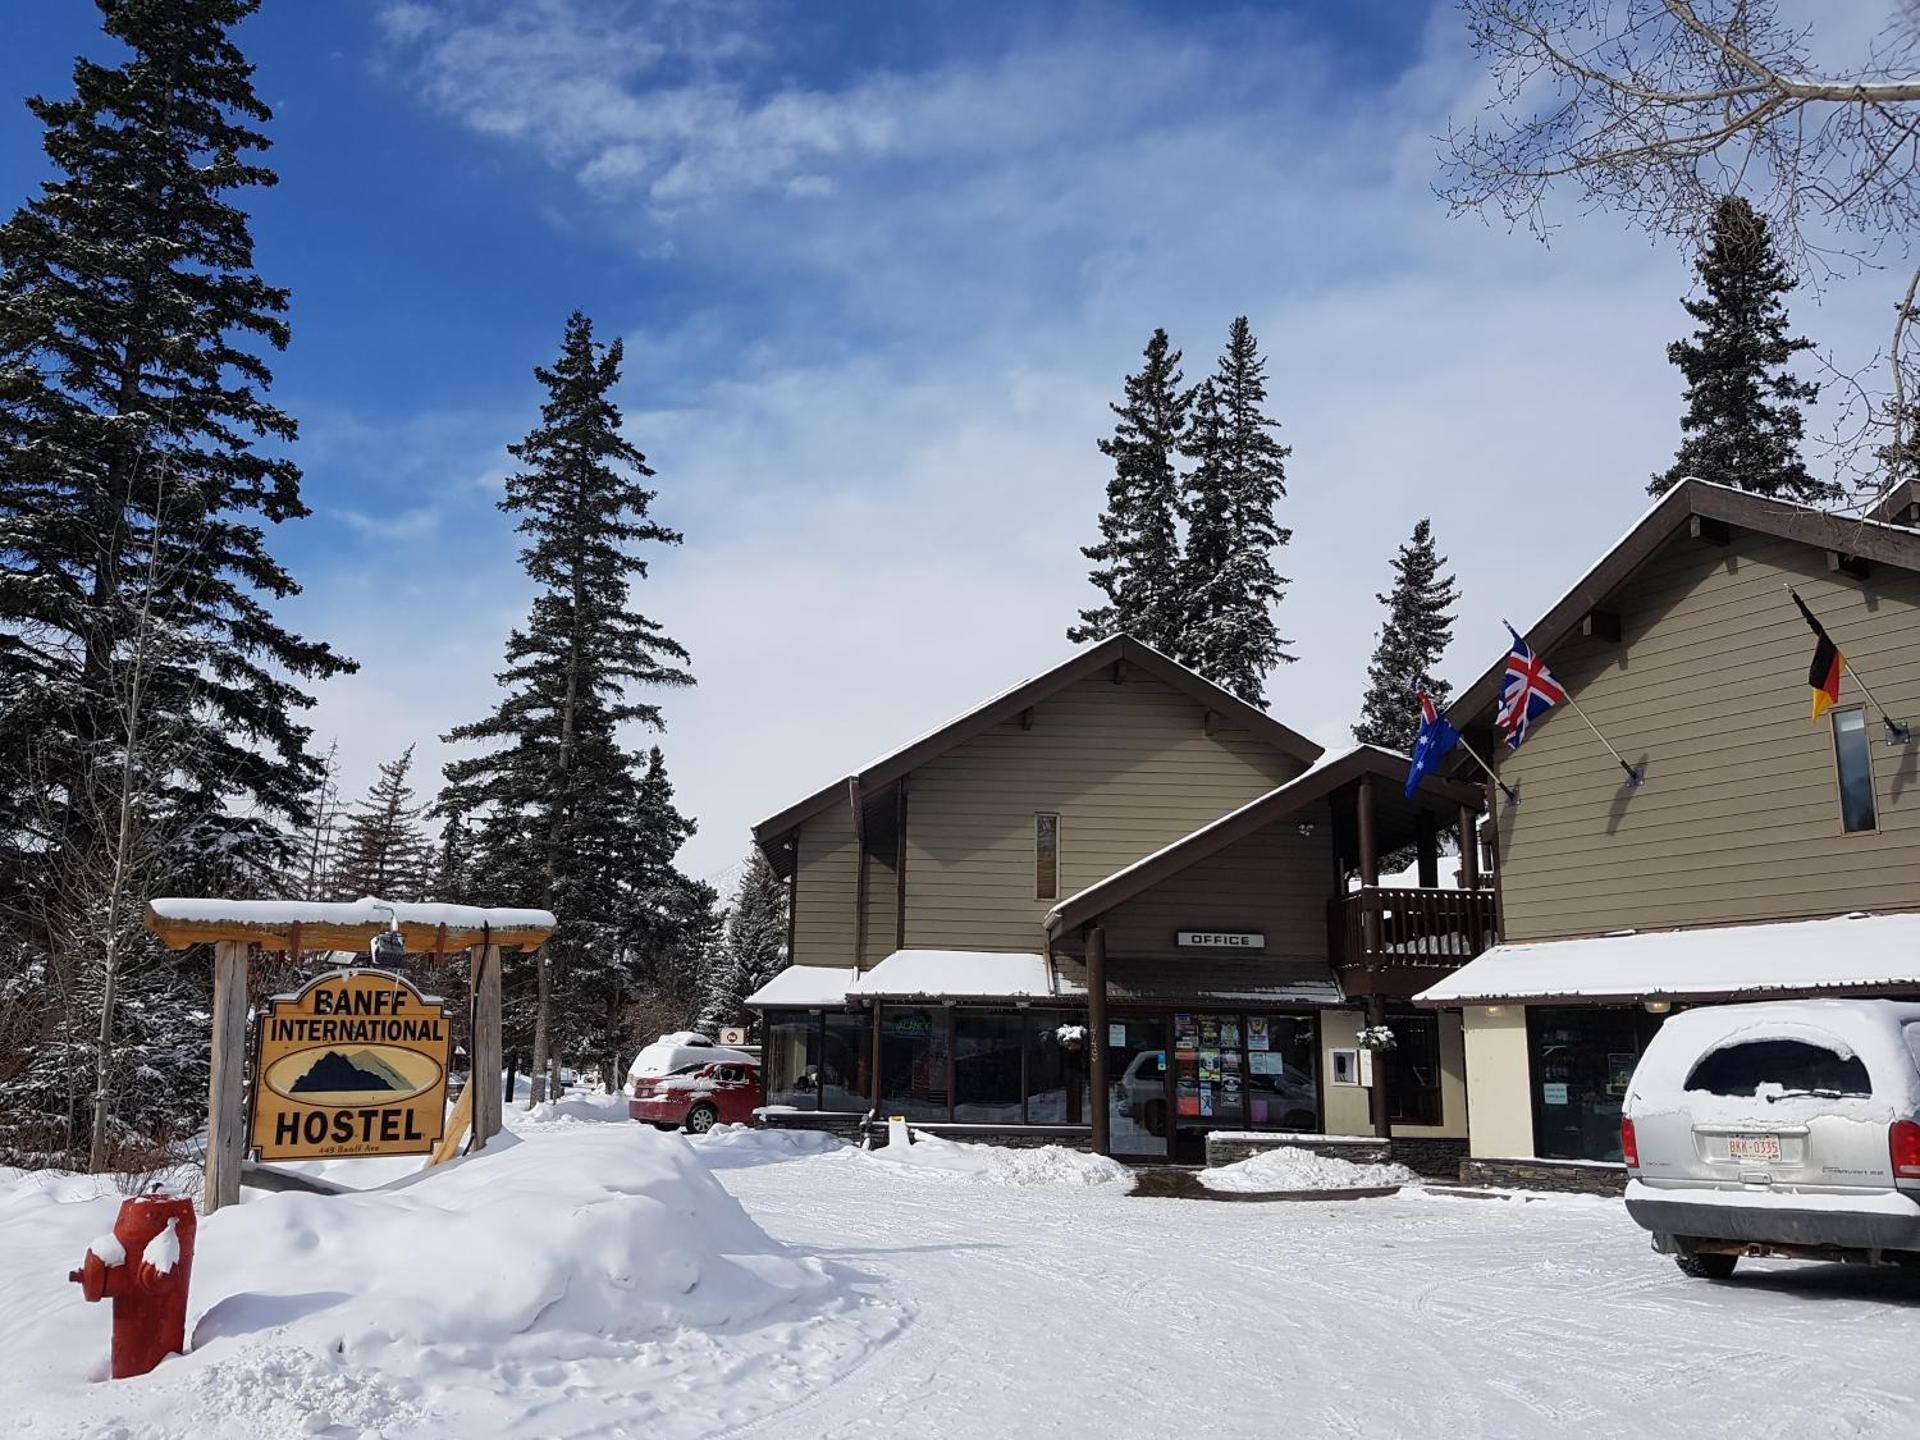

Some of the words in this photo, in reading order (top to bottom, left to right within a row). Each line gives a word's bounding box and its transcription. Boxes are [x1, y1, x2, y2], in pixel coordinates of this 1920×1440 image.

[1191, 934, 1250, 946] OFFICE
[313, 988, 408, 1016] BANFF
[270, 1019, 444, 1042] INTERNATIONAL
[274, 1108, 422, 1146] HOSTEL
[337, 1143, 362, 1153] Banff
[364, 1143, 380, 1153] Ave
